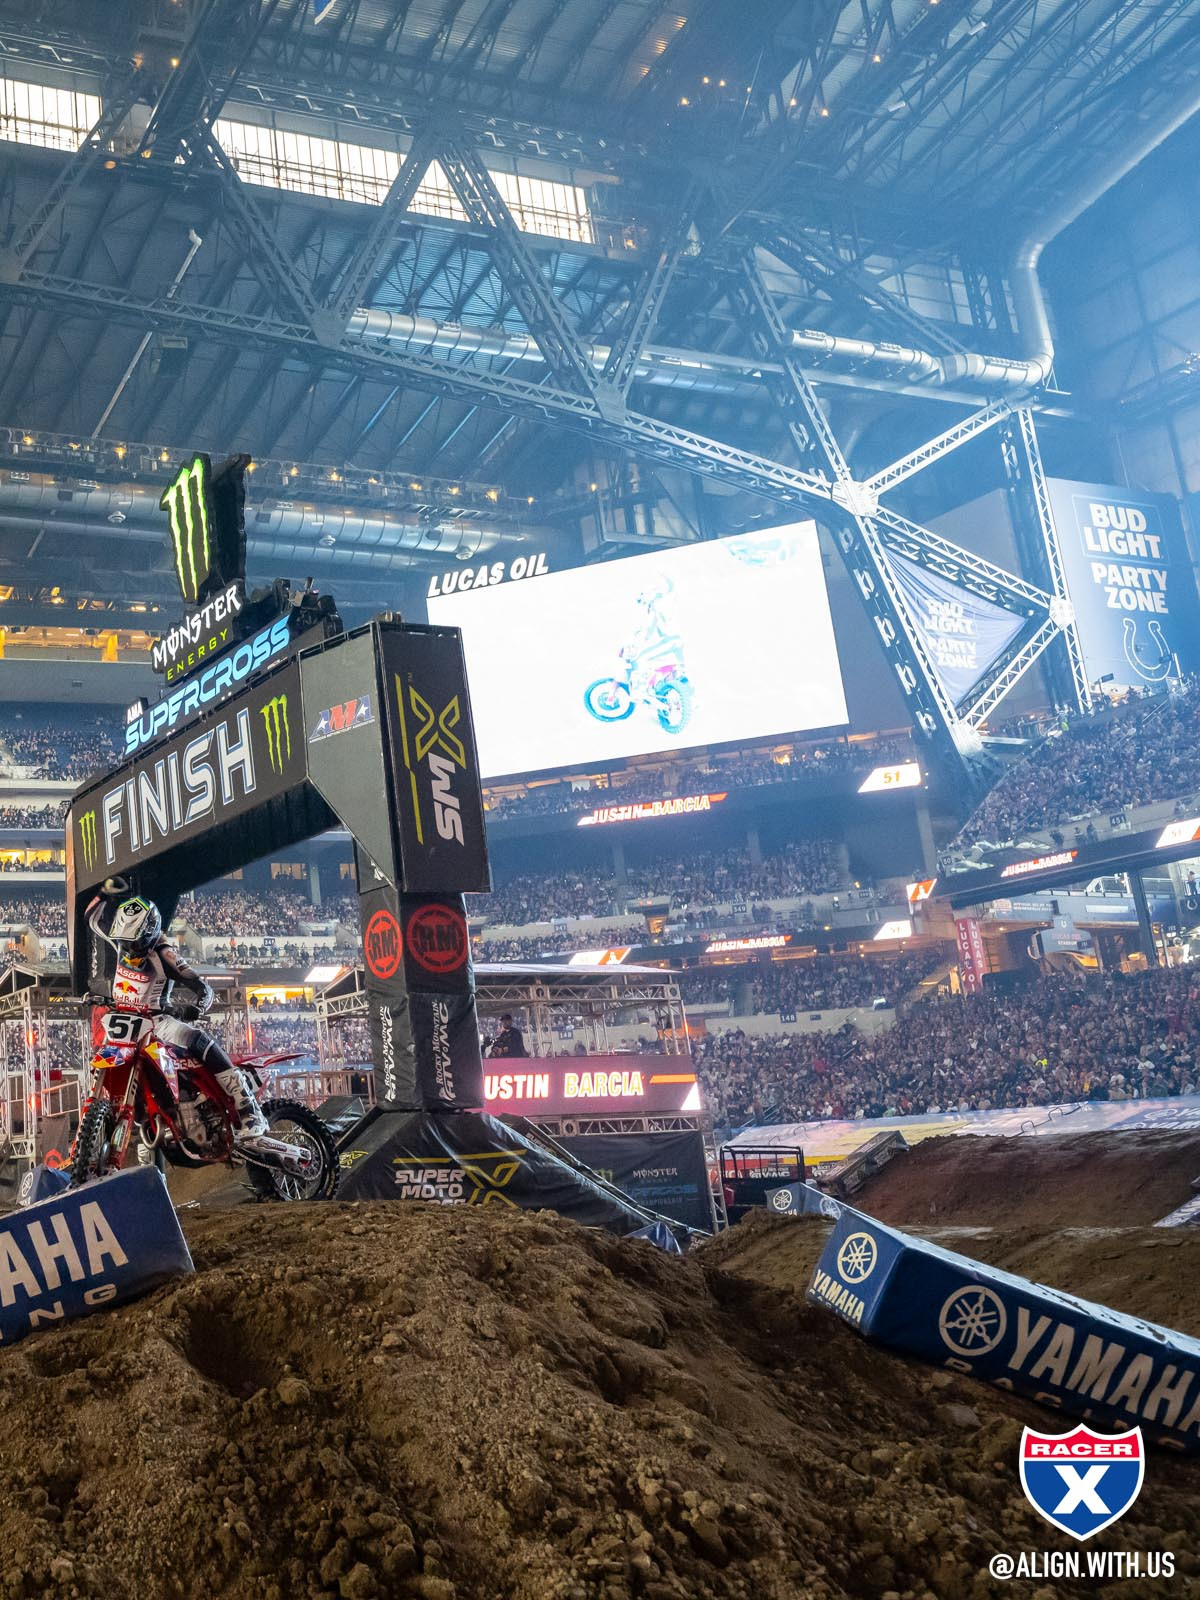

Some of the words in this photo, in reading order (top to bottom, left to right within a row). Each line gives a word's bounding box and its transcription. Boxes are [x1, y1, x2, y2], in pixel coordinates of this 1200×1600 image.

[1089, 503, 1147, 532] BUD
[1083, 526, 1160, 559] LIGHT
[427, 561, 505, 597] LUCAS
[510, 553, 549, 580] OIL
[1090, 562, 1167, 591] PARTY
[1104, 586, 1169, 614] ZONE
[153, 585, 241, 668] MONSTER
[167, 628, 228, 680] ENERGY
[928, 637, 977, 656] PARTY
[936, 651, 978, 669] ZONE
[125, 614, 290, 756] SUPERCROSS
[127, 701, 143, 723] AMA
[309, 694, 373, 741] AMA
[102, 707, 257, 864] FINISH
[883, 770, 900, 784] 51
[591, 804, 643, 824] JUSTIN
[651, 795, 711, 817] BARCIA
[969, 921, 984, 969] LUCAS
[108, 1015, 144, 1043] 51
[380, 1007, 389, 1056] MOUNTAIN
[431, 1001, 441, 1053] MOUNTAIN
[780, 1014, 796, 1022] 148
[436, 1057, 444, 1084] ROCKY
[484, 1074, 549, 1100] USTIN
[564, 1071, 644, 1098] BARCIA
[395, 1169, 466, 1184] SUPER
[632, 1168, 677, 1178] MONSTER
[401, 1184, 463, 1199] MOTO
[813, 1269, 864, 1322] YAMAHA
